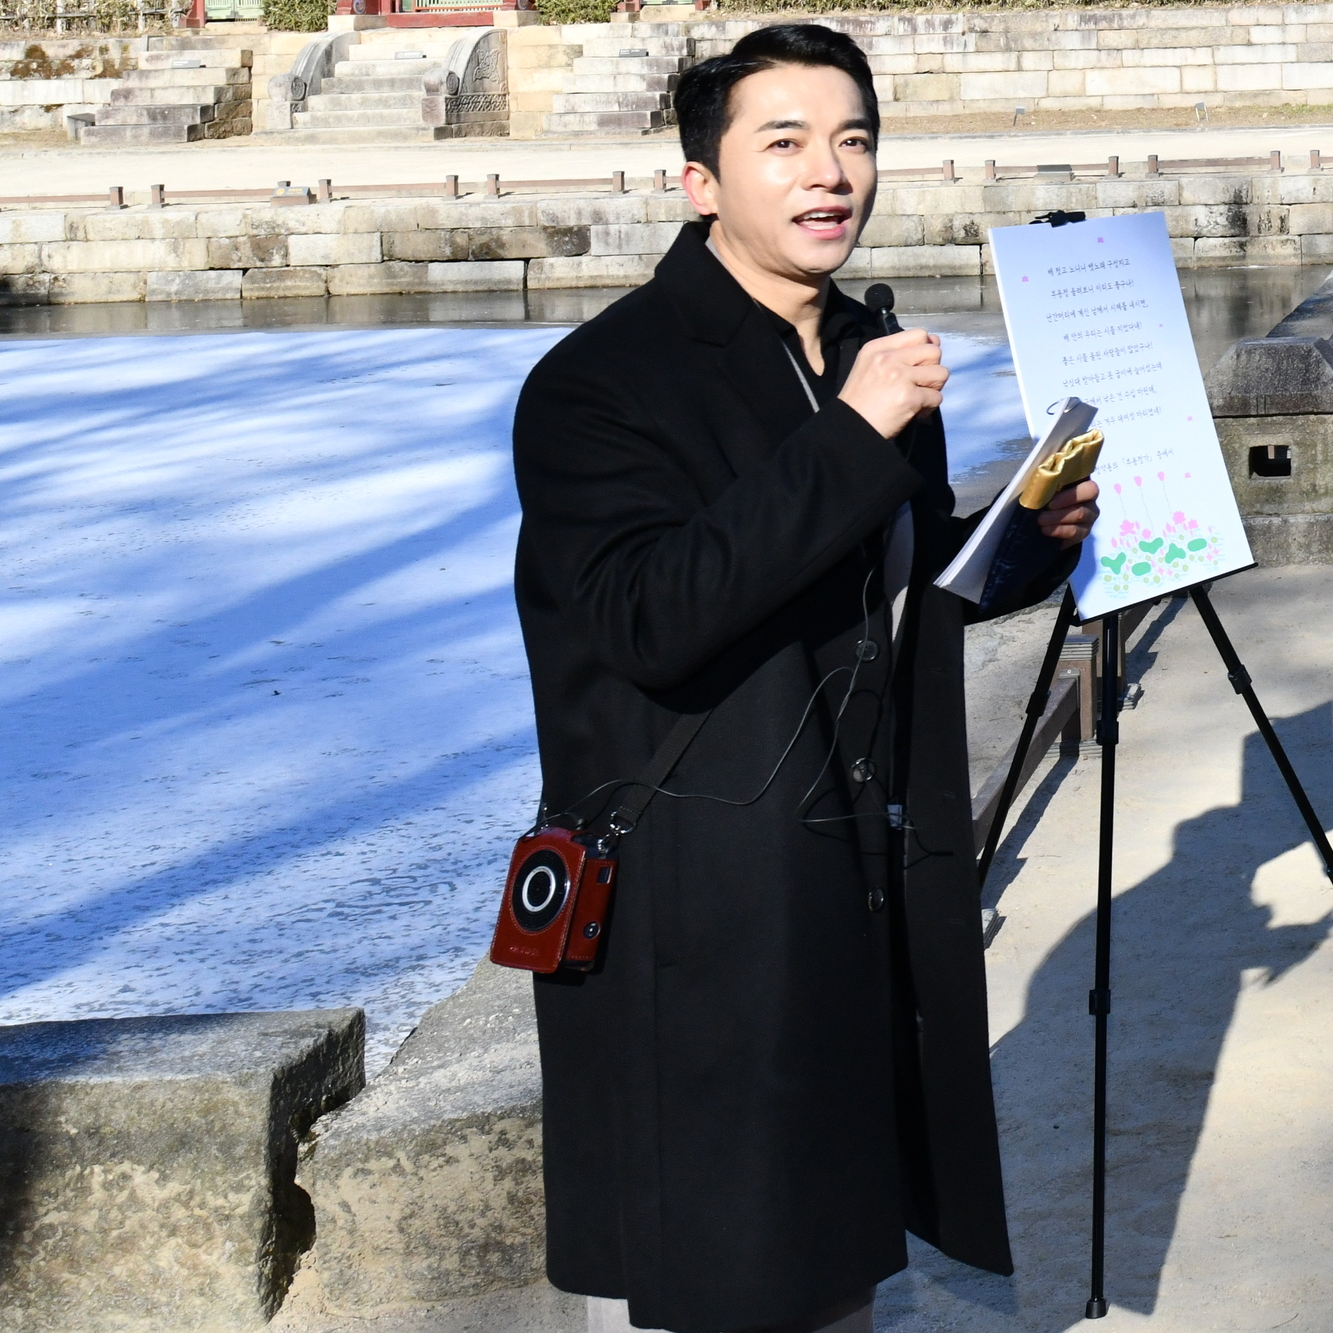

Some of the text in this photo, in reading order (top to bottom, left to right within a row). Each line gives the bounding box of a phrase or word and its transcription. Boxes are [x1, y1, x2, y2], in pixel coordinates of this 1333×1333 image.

[1048, 267, 1054, 276] 배
[1107, 258, 1130, 269] 구성지고
[1051, 289, 1069, 299] 부용정
[1096, 282, 1113, 291] 이리도
[1063, 334, 1069, 342] 배
[1071, 331, 1083, 341] 안의
[1085, 329, 1102, 338] 우리는
[1104, 326, 1116, 335] 시를
[1063, 355, 1074, 366] 좋은
[1077, 353, 1088, 363] 시를
[1104, 346, 1126, 357] 사람들이
